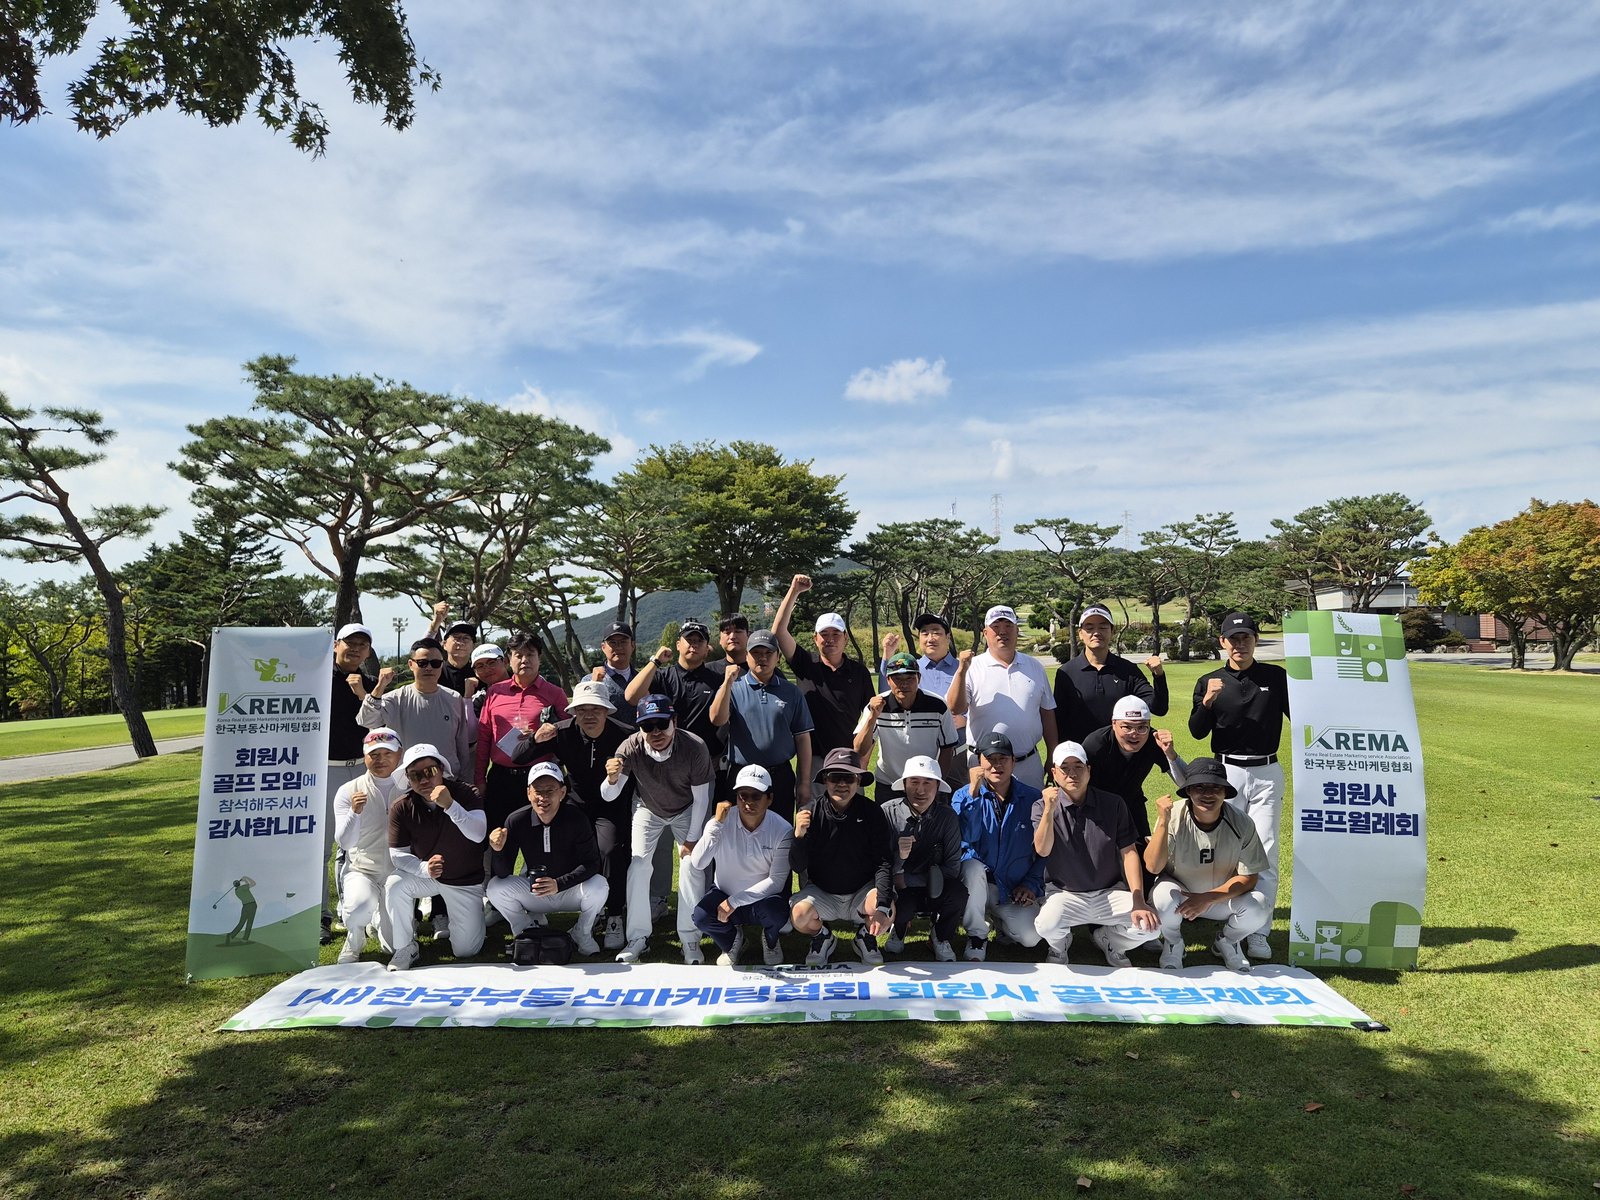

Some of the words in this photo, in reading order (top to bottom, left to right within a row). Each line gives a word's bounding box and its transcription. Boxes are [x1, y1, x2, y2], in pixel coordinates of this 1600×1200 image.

[272, 673, 296, 683] Golf
[218, 692, 320, 715] KREMA
[215, 722, 321, 735] 한국부동산마케팅협회
[1304, 725, 1409, 752] KREMA
[235, 747, 299, 767] 회원사
[1304, 758, 1413, 773] 한국부동산마케팅협회
[213, 773, 255, 793] 골프
[260, 771, 316, 791] 모임에
[219, 796, 308, 813] 참석해주셔서
[1323, 781, 1396, 807] 회원사
[208, 815, 316, 839] 감사합니다
[1301, 809, 1419, 836] 골프월례회
[1200, 849, 1215, 864] FJ
[288, 982, 871, 1007] (사)한국부동산마케팅협회
[887, 982, 1039, 1003] 회원사
[1050, 985, 1318, 1006] 골프월례회
